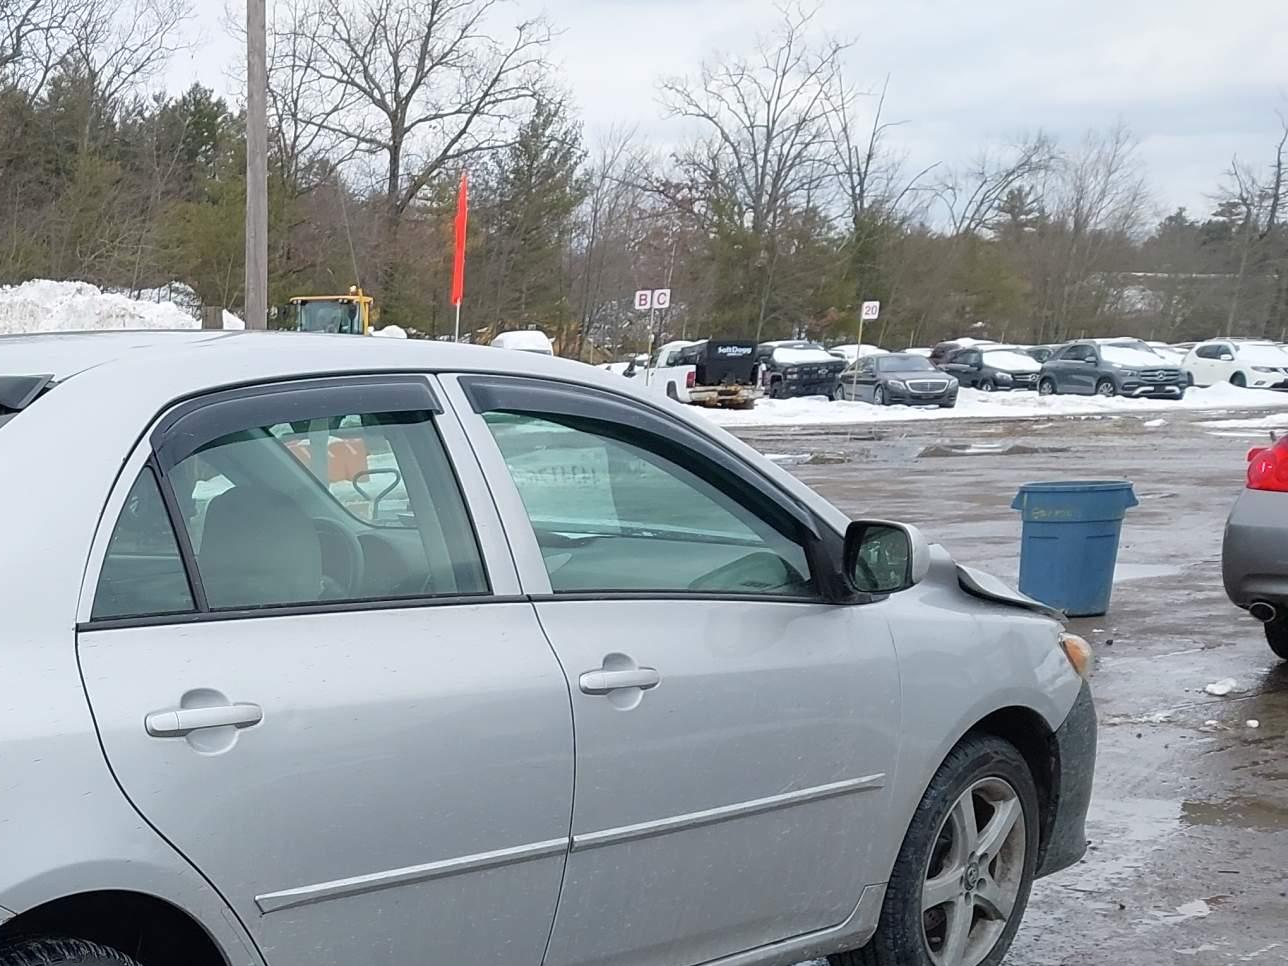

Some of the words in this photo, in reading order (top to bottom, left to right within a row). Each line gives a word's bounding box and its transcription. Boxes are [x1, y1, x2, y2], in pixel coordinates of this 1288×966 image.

[639, 293, 648, 307] B
[657, 292, 667, 306] C
[864, 305, 878, 316] 20
[718, 345, 753, 354] SaltDogg
